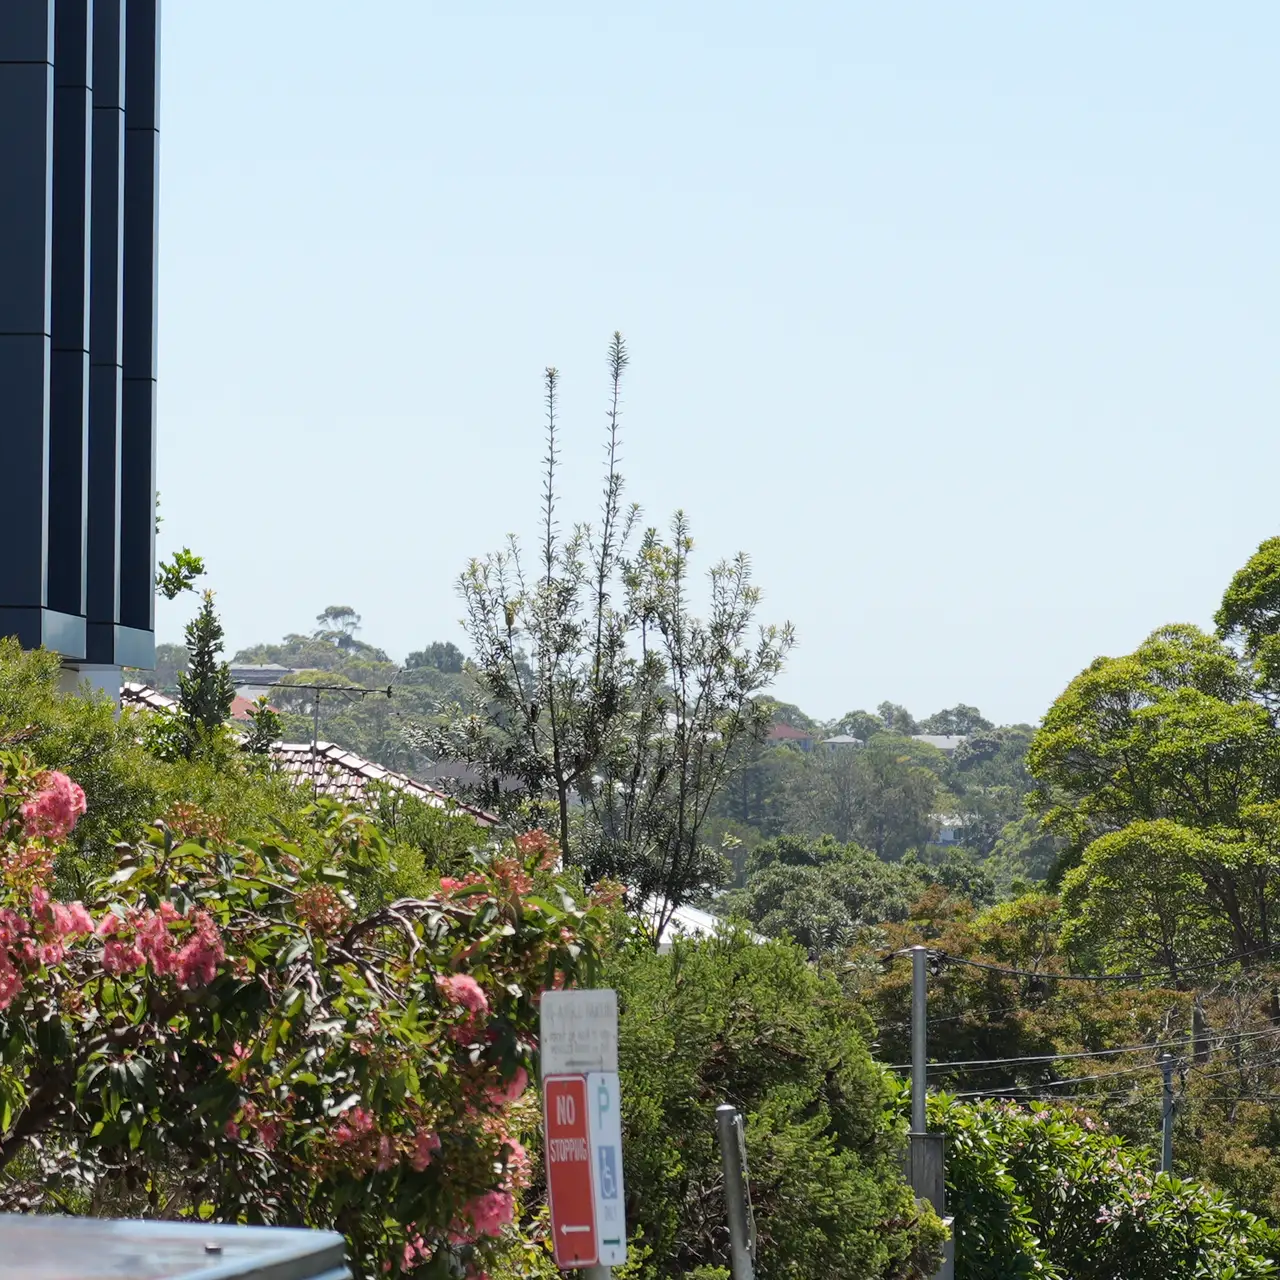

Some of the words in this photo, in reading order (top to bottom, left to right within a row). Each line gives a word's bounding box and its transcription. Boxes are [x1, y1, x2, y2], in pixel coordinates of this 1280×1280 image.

[556, 1094, 576, 1126] NO
[597, 1086, 610, 1131] P
[550, 1137, 588, 1163] STOPPING
